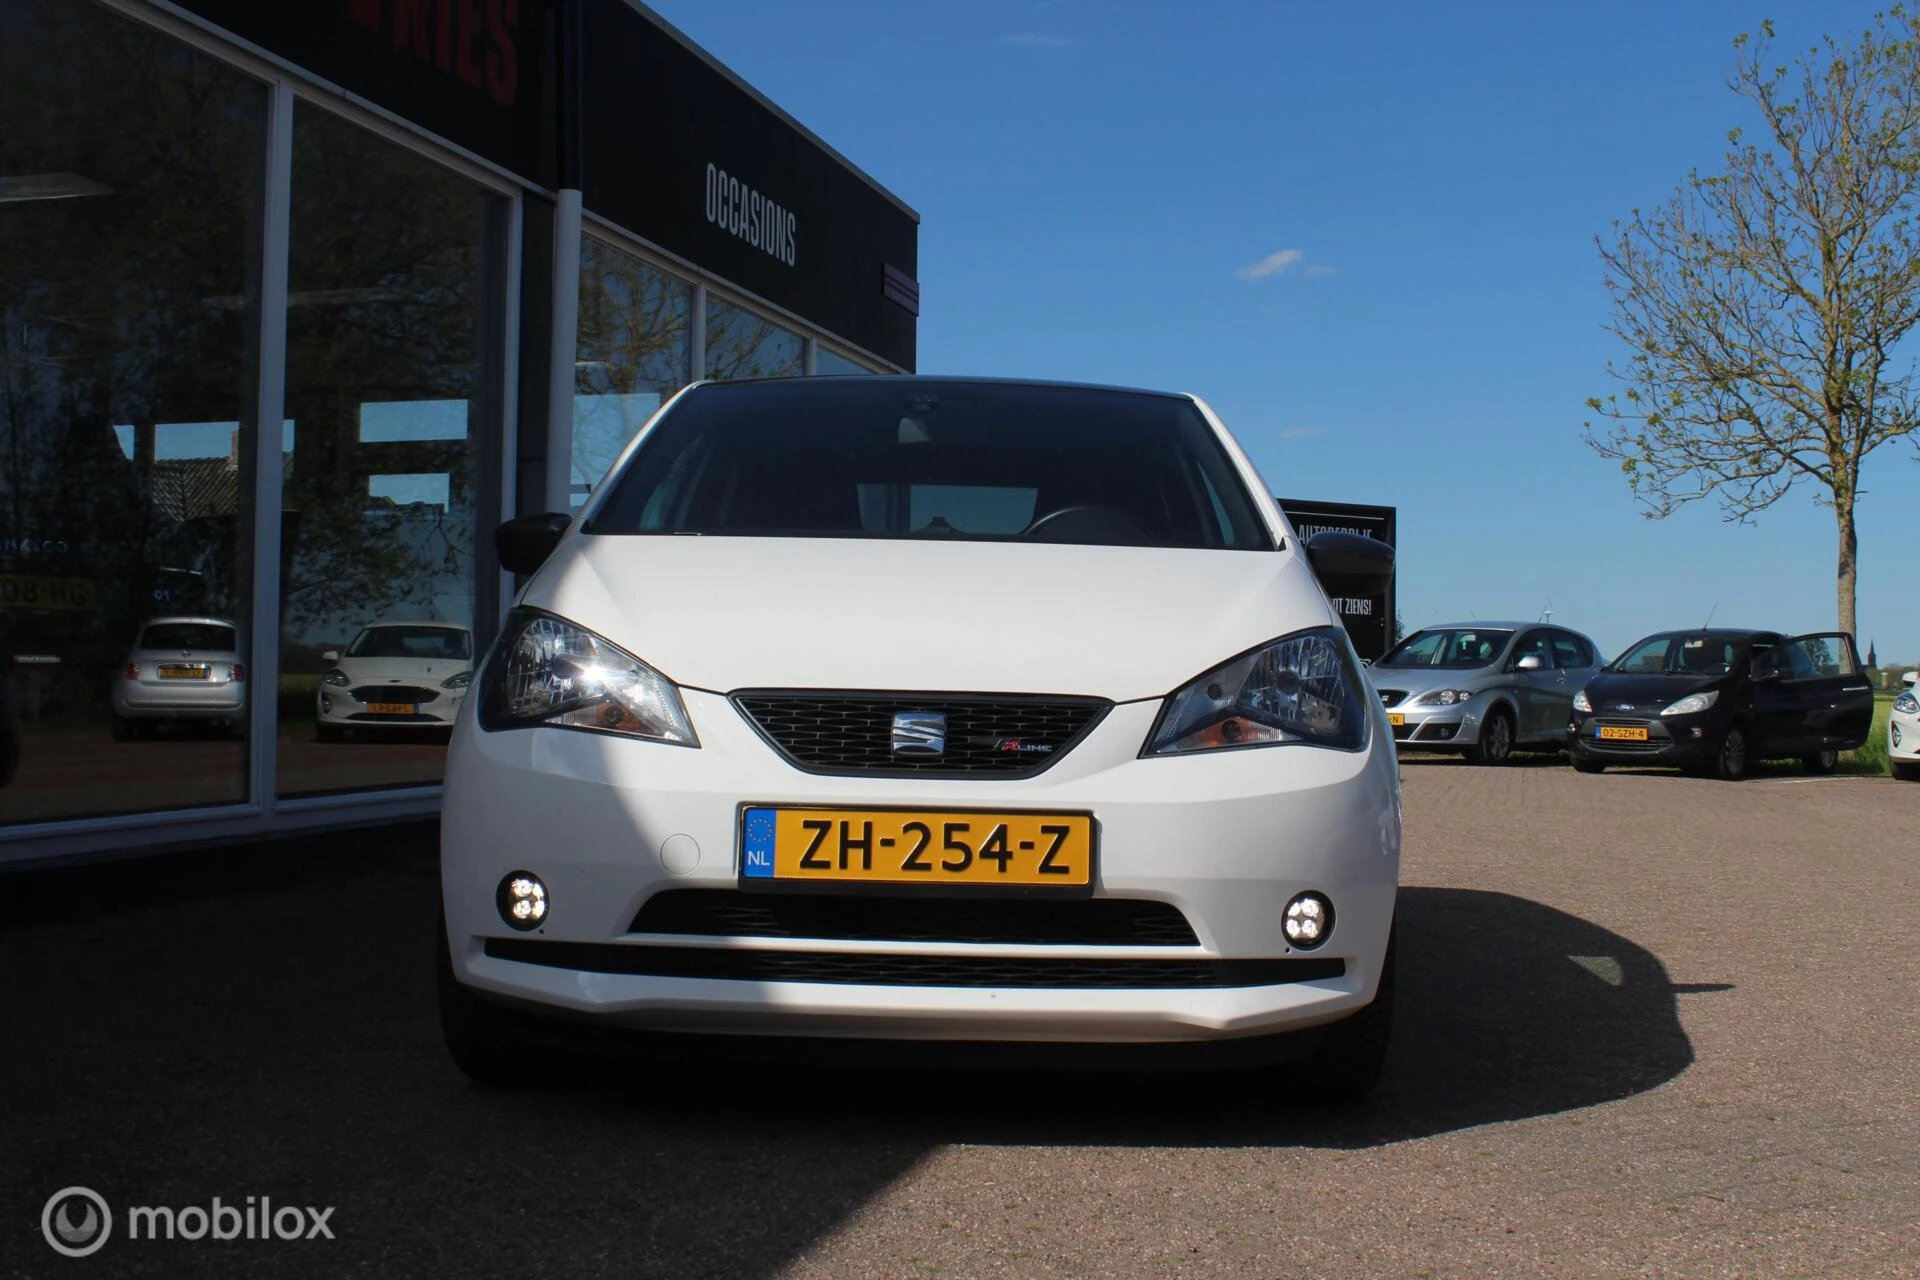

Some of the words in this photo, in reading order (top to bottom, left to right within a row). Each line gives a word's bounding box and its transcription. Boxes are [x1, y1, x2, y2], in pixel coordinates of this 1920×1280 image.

[347, 0, 519, 106] IES
[706, 162, 796, 267] OCCASIONS
[1331, 598, 1343, 614] OT
[1345, 598, 1372, 615] ZIENS!
[1603, 728, 1644, 738] 02-SZH-4
[747, 850, 770, 866] NL
[799, 819, 1071, 875] ZH-254-Z
